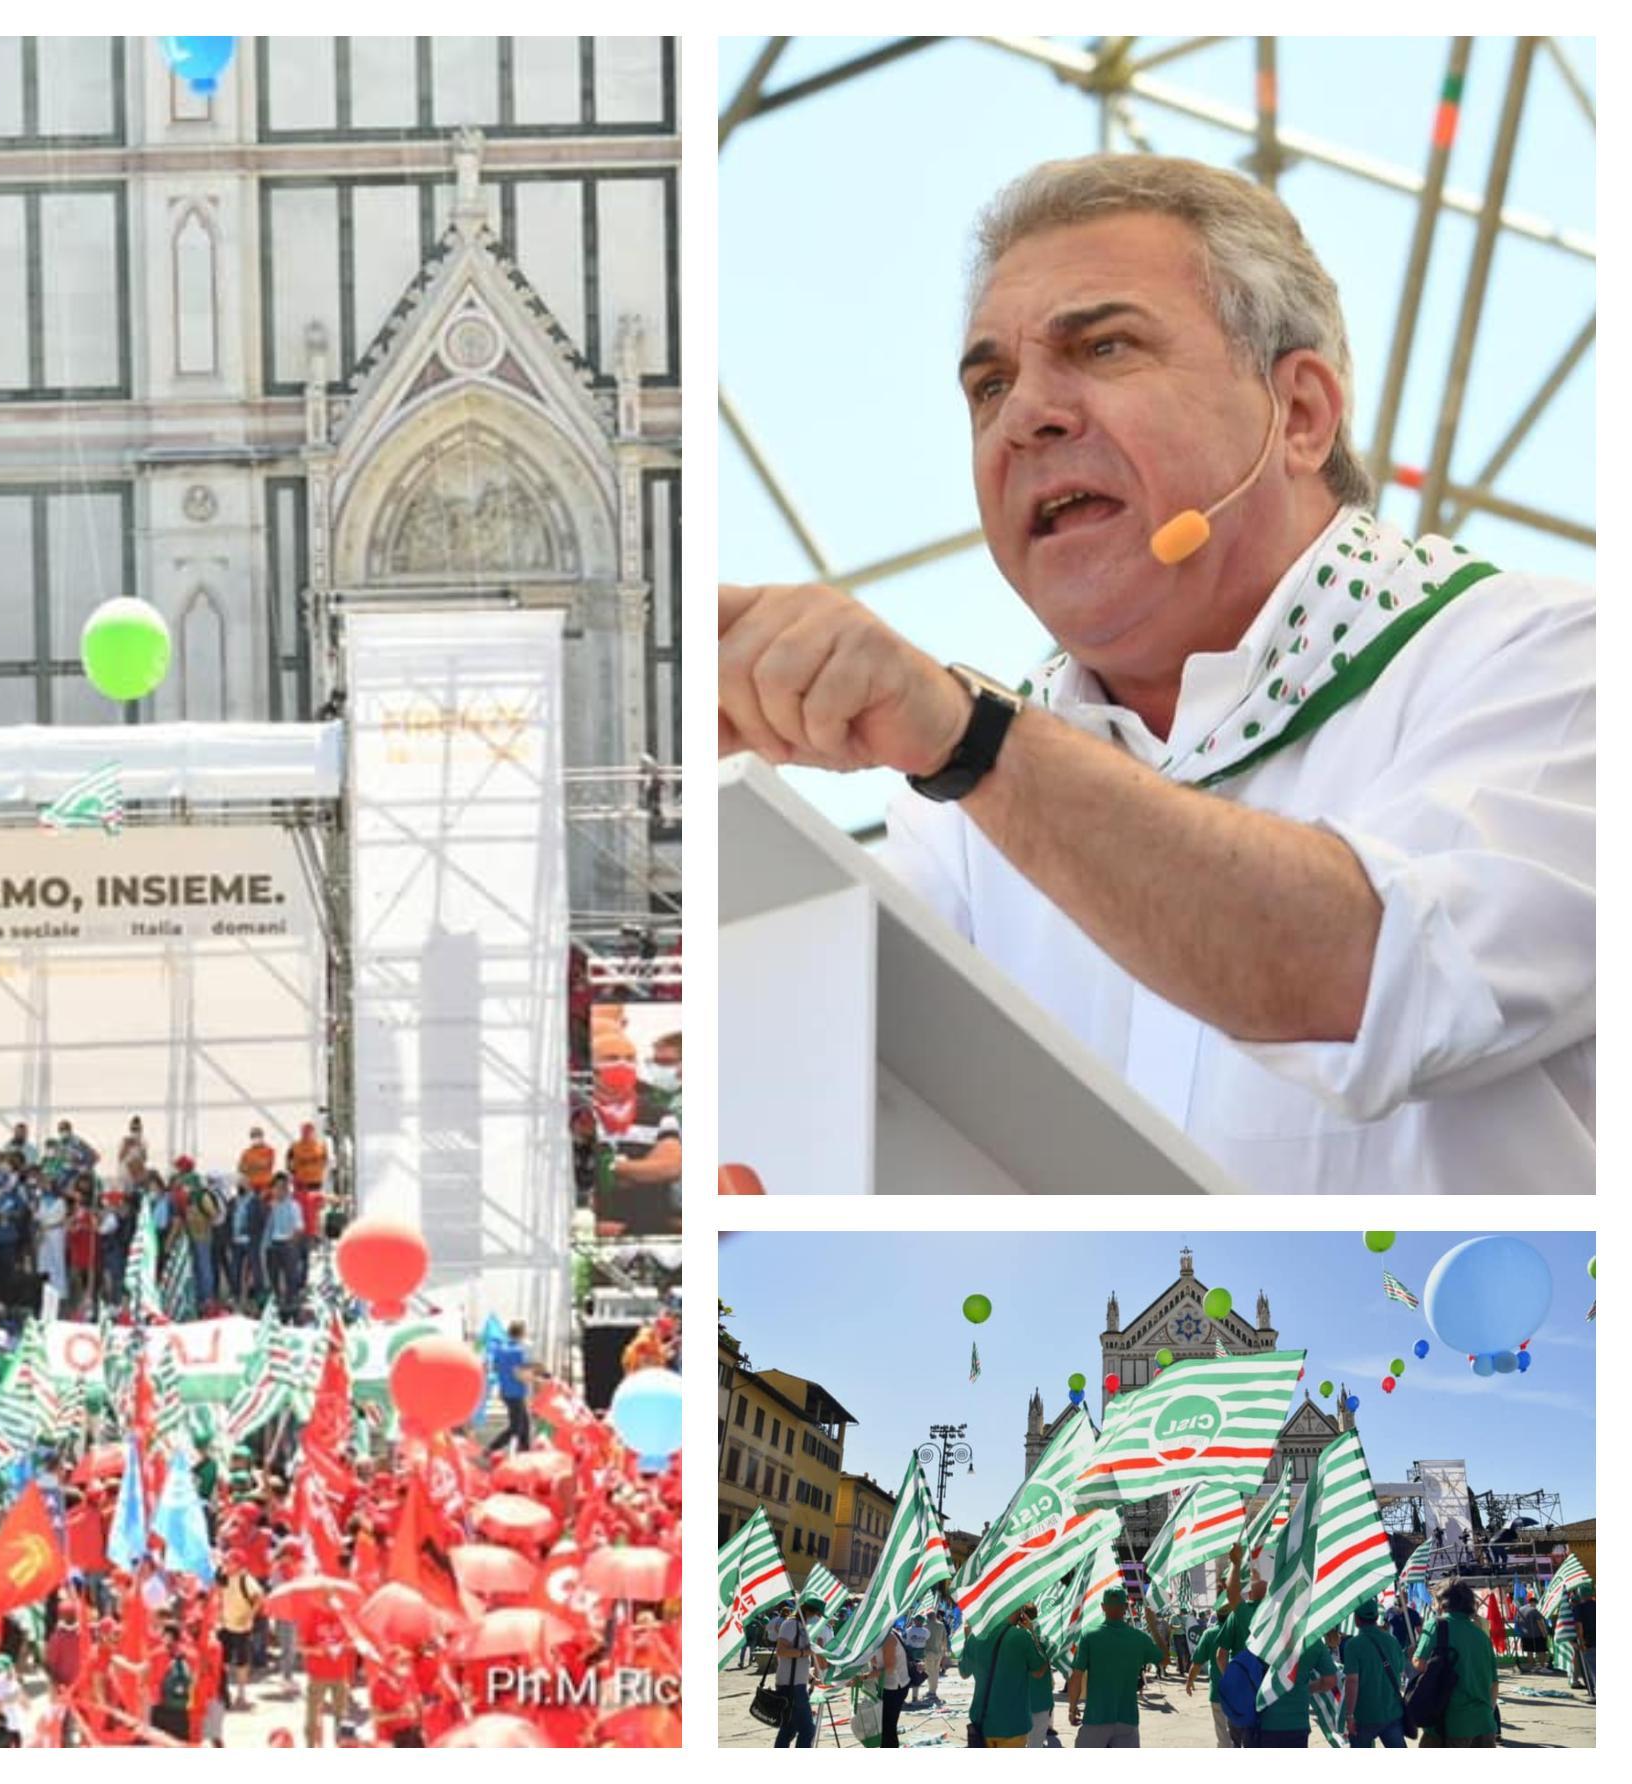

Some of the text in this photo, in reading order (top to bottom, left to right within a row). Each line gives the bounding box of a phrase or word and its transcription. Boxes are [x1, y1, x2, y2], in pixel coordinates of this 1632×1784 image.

[96, 874, 286, 907] INSIEME.
[11, 919, 80, 938] sociale
[131, 920, 182, 937] Italia
[211, 918, 286, 936] domani
